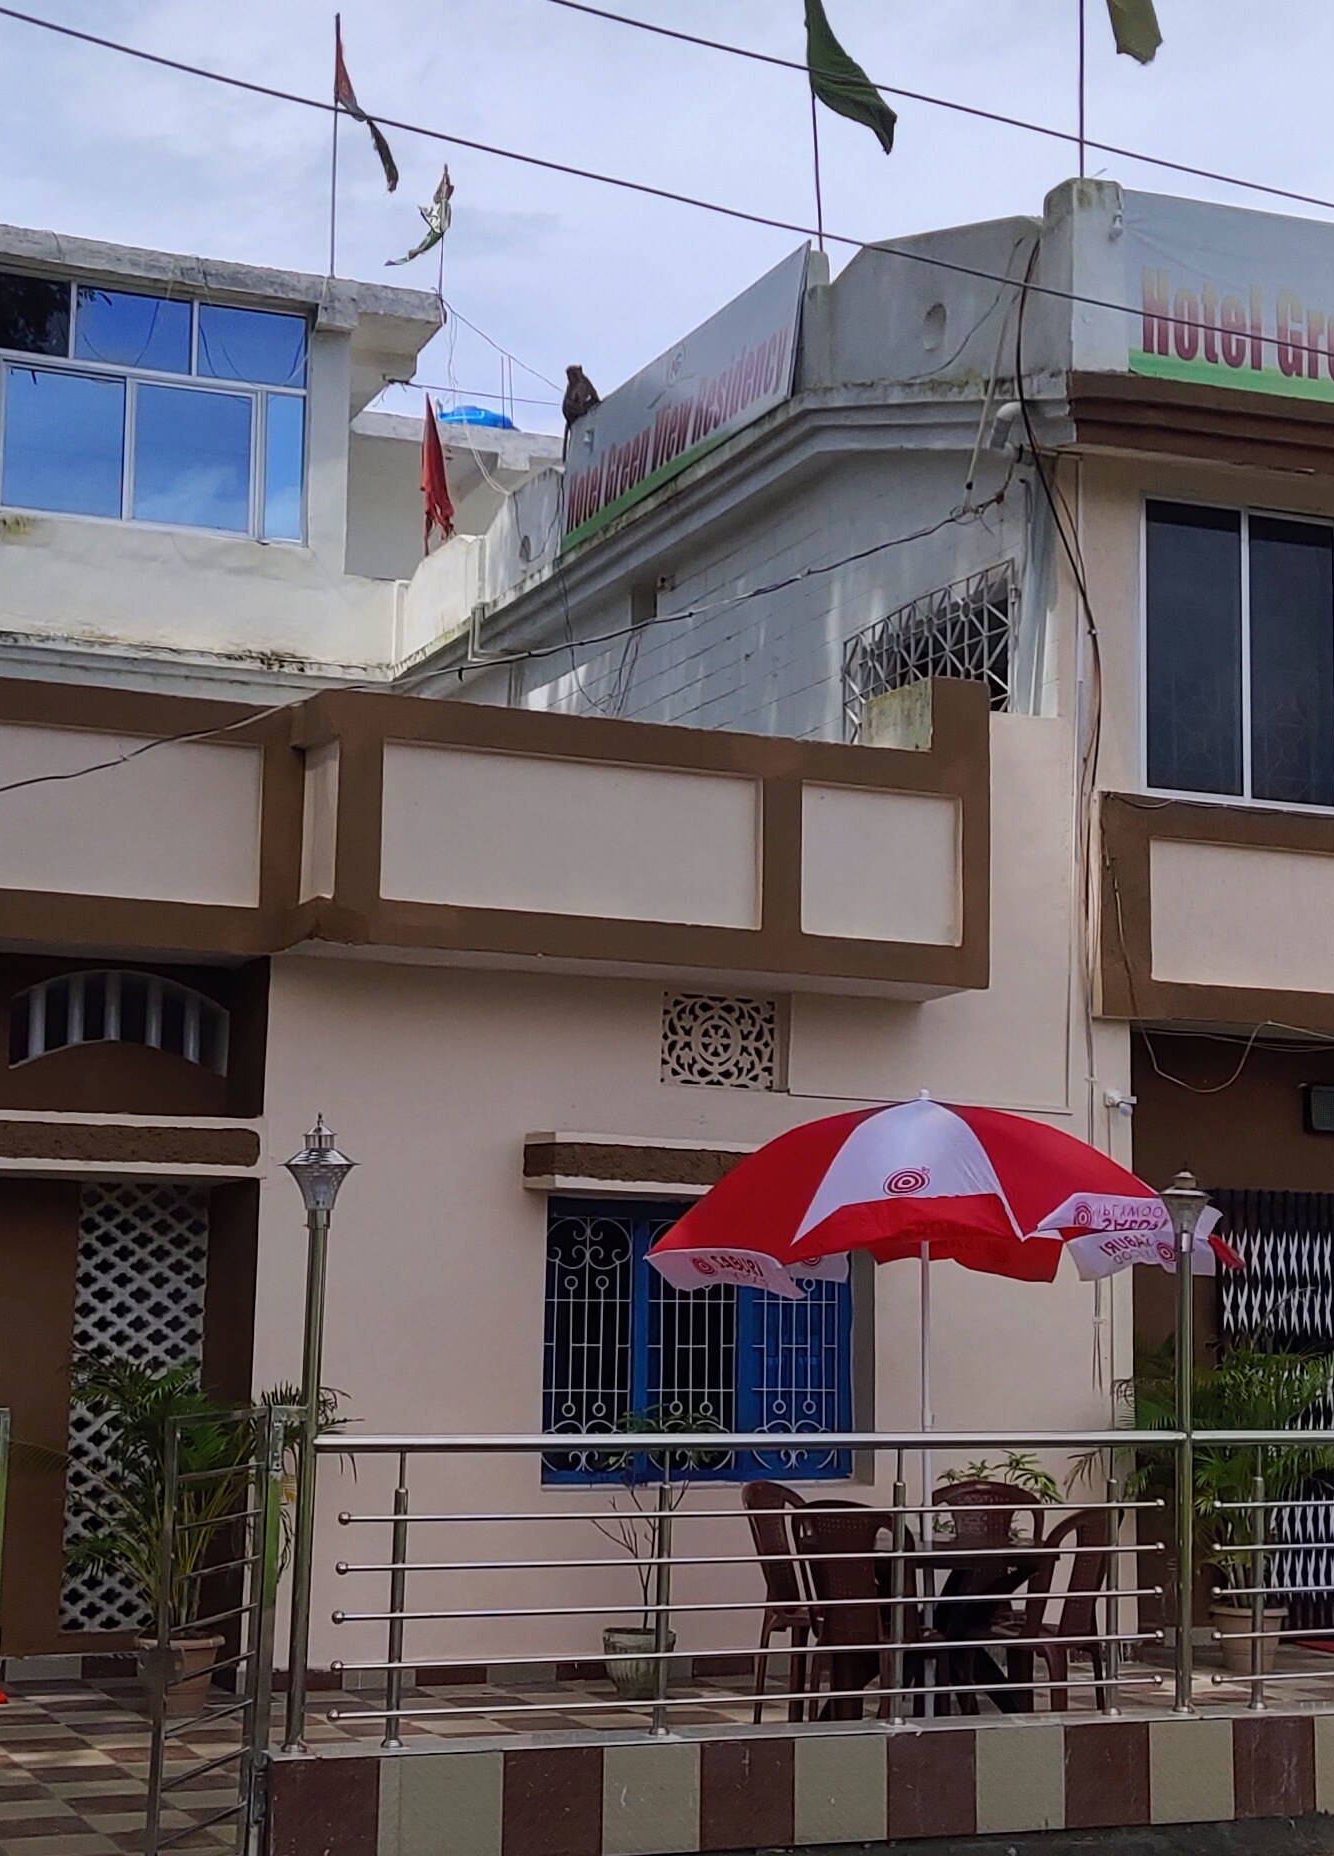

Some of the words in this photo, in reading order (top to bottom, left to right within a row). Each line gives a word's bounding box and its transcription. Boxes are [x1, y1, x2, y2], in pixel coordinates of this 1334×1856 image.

[1140, 266, 1264, 371] Hotel
[566, 452, 604, 534] Hotel
[605, 430, 651, 504] Green
[652, 399, 695, 469] View
[692, 327, 790, 445] Residency
